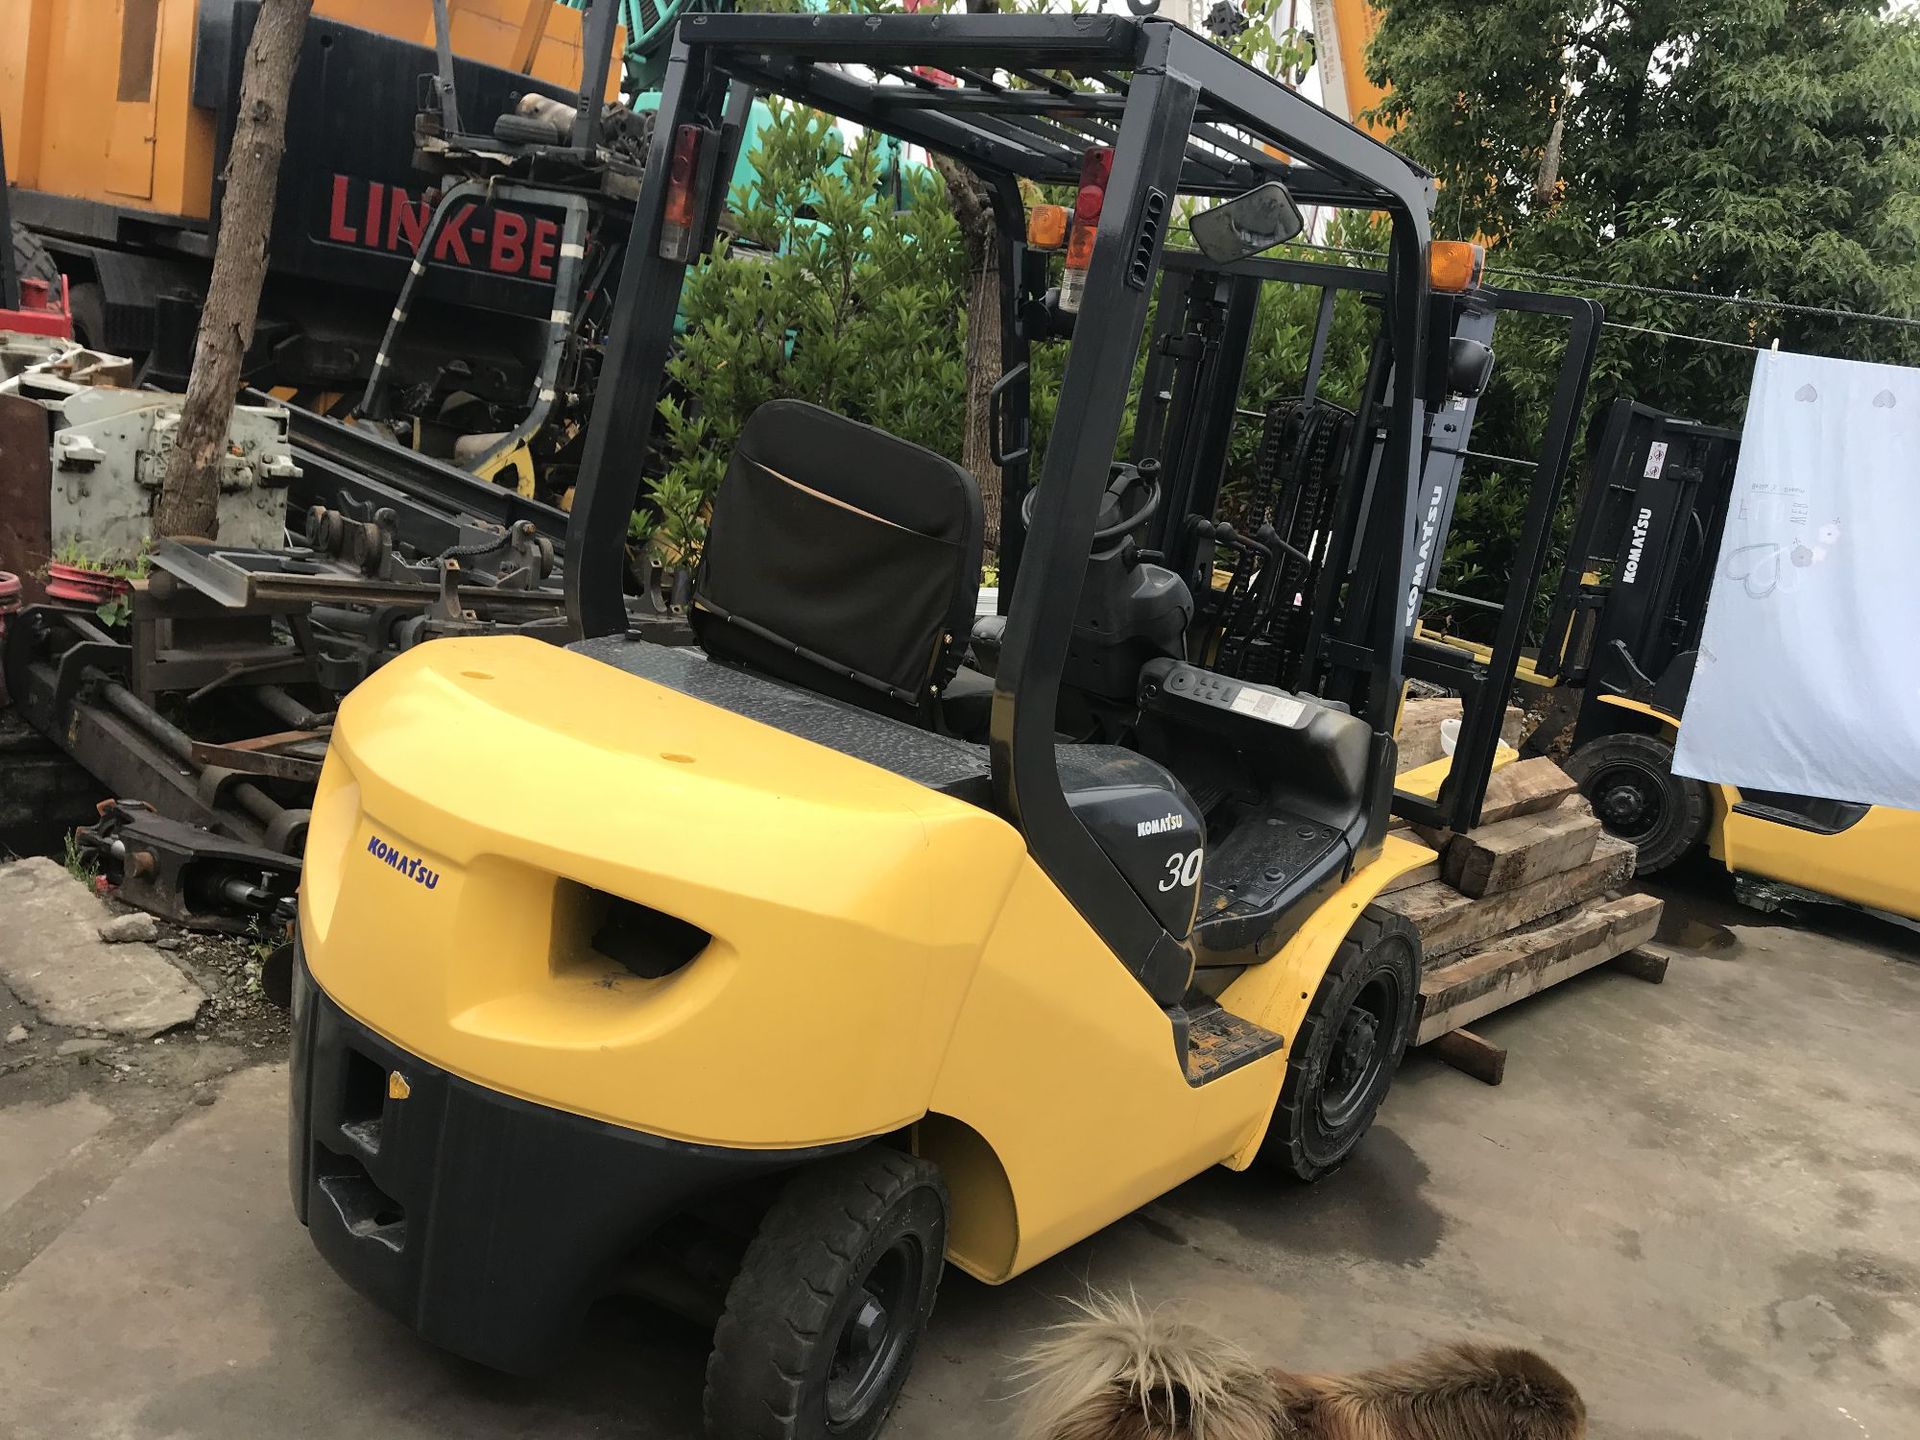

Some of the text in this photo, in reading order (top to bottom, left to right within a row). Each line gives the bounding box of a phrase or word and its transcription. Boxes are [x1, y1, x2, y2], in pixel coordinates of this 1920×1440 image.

[329, 173, 557, 280] LINK-BE
[1405, 485, 1443, 627] KOMATSU
[1622, 507, 1652, 584] KOMATSU
[1137, 812, 1183, 837] KOMATSU
[367, 835, 440, 890] KOMATSU
[1158, 848, 1204, 892] 30
